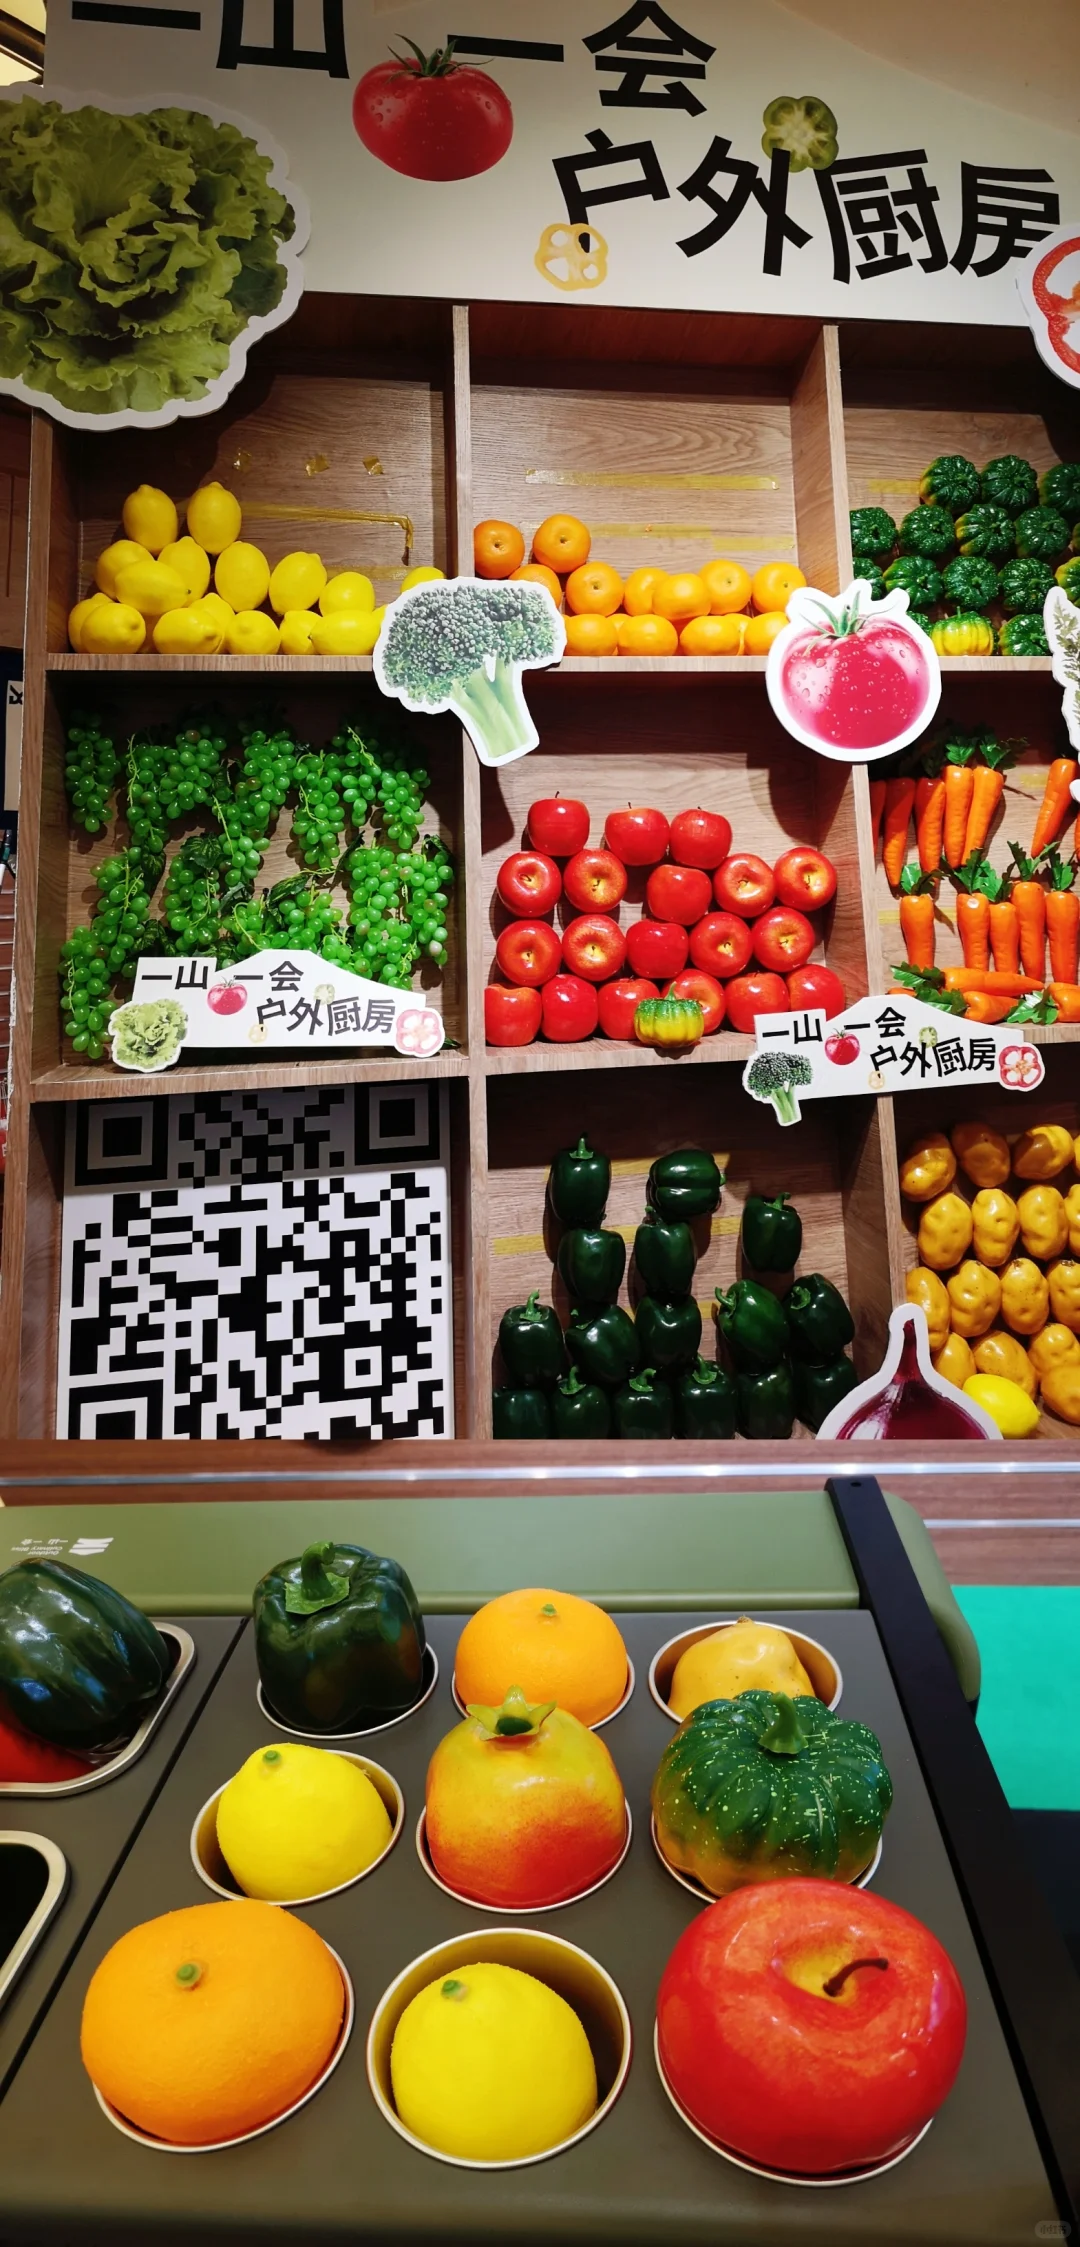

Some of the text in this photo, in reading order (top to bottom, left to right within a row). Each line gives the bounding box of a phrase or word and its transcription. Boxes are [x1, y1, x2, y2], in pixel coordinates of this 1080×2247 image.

[552, 128, 1060, 283] 户外厨房
[256, 996, 396, 1036] 户外厨房
[869, 1037, 996, 1078] 户外厨房
